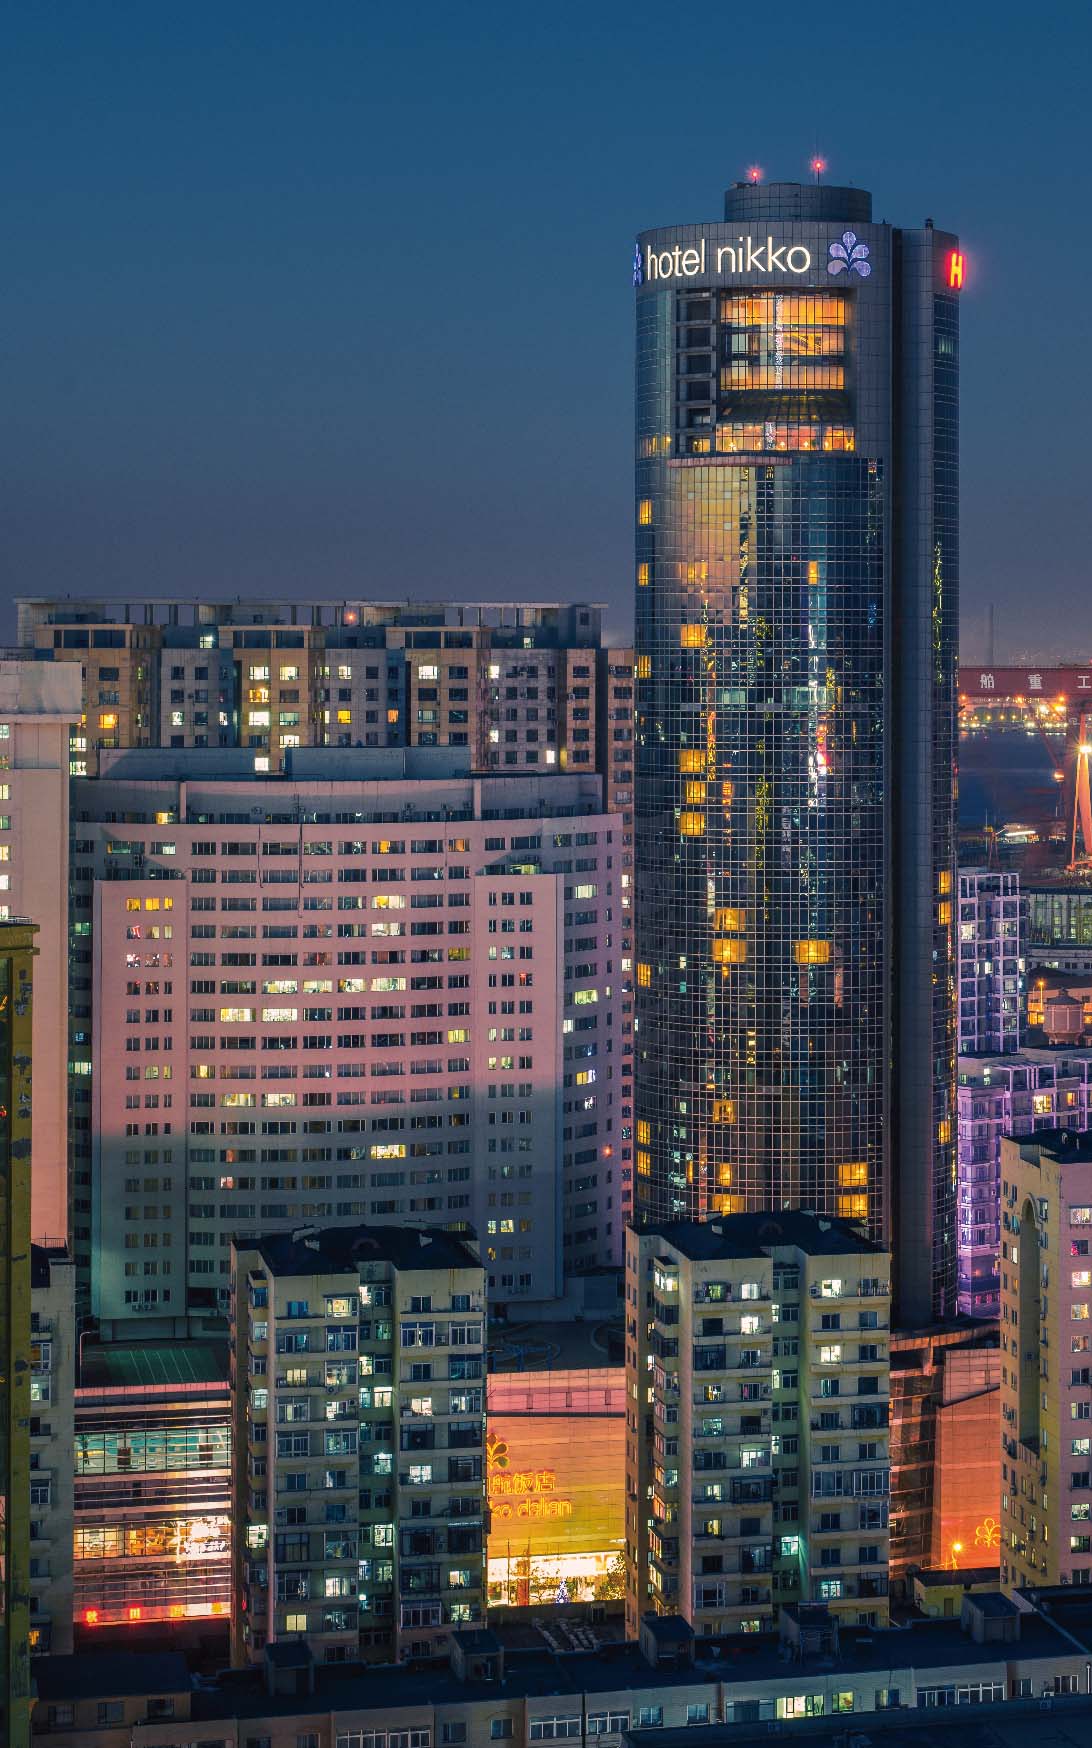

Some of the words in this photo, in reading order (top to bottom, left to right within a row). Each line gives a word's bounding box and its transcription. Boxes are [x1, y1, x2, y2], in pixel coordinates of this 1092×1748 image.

[647, 238, 705, 280] hotel
[717, 236, 811, 273] nikko
[949, 251, 965, 289] H
[487, 1471, 556, 1495] 航饭店
[517, 1496, 572, 1519] dalian
